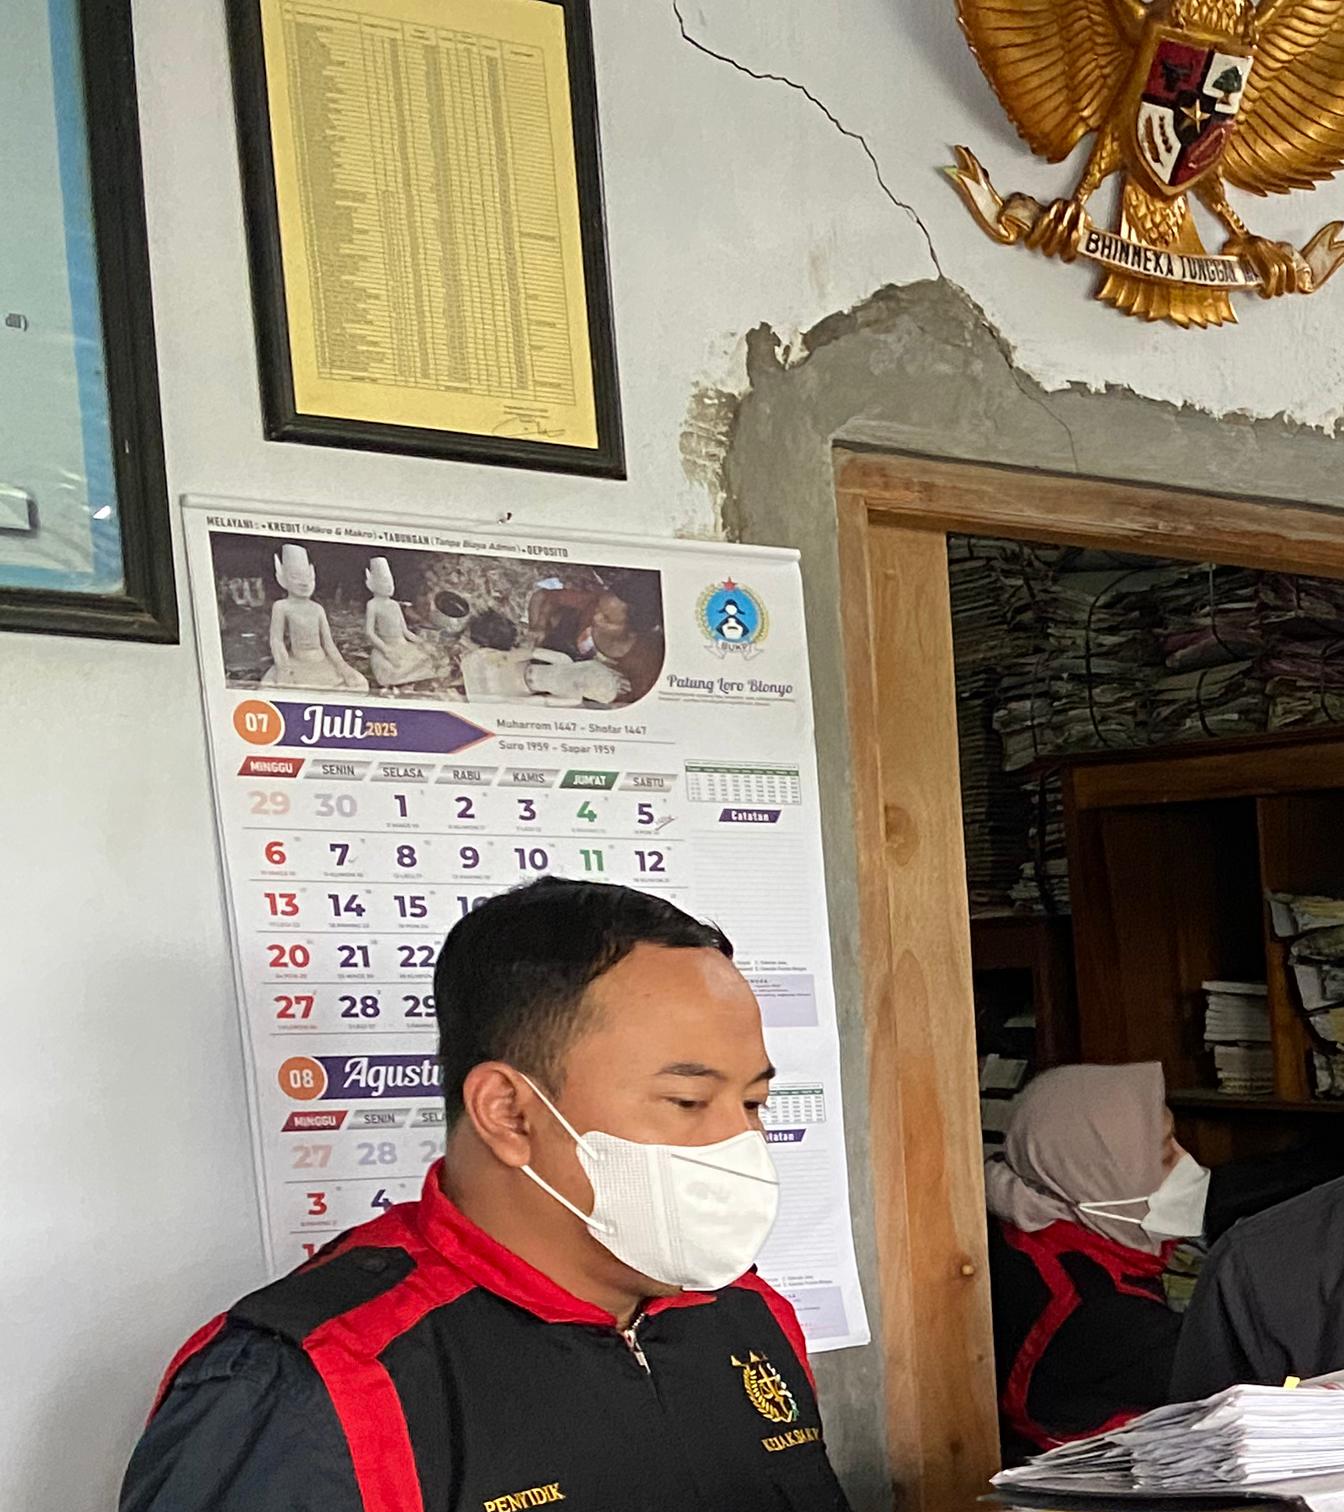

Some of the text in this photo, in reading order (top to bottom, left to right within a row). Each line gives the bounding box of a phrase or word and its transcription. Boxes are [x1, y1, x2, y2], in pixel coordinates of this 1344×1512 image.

[1085, 231, 1174, 277] BHINNEKA
[268, 522, 300, 533] KREDIT
[527, 545, 569, 558] DEPOSITO
[667, 674, 714, 693] Patung
[717, 677, 744, 694] Loro
[747, 678, 793, 698] Blonyo
[244, 705, 398, 745] 07 Juli 2025
[496, 719, 552, 731] Muharrom
[554, 720, 577, 731] 1447
[624, 724, 648, 735] 1447
[499, 740, 525, 751] Suro
[526, 741, 550, 752] 1959
[560, 743, 591, 755] Sapar
[593, 744, 616, 755] 1959
[250, 760, 294, 774] MINGGU
[322, 764, 355, 776] SENIN
[383, 766, 424, 779] SELASA
[452, 769, 481, 782] RABU
[512, 771, 545, 783] KAMIS
[632, 776, 665, 788] SABTU
[248, 790, 291, 816] 29
[313, 793, 359, 818] 30
[393, 794, 408, 818] 1
[454, 796, 476, 820] 2
[516, 799, 537, 821] 3
[575, 800, 598, 823] 4
[636, 802, 655, 825] 5
[731, 810, 770, 821] Catatan
[264, 840, 287, 865] 6
[329, 843, 350, 867] 7
[396, 844, 418, 868] 8
[459, 846, 480, 870] 9
[513, 847, 550, 871] 10
[579, 848, 605, 873] 11
[633, 850, 667, 873] 12
[263, 891, 300, 917] 13
[327, 893, 367, 917] 14
[393, 894, 428, 919] 15
[266, 943, 311, 969] 20
[336, 944, 371, 969] 21
[397, 944, 437, 969] 22
[273, 994, 317, 1020] 27
[337, 994, 381, 1019] 28
[288, 1056, 443, 1097] 08 Agustu
[293, 1115, 337, 1127] MINGGU
[363, 1112, 396, 1125] SENIN
[766, 1131, 795, 1142] tatan
[291, 1144, 333, 1169] 27
[356, 1141, 398, 1166] 28
[305, 1191, 328, 1216] 3
[370, 1188, 394, 1213] 4
